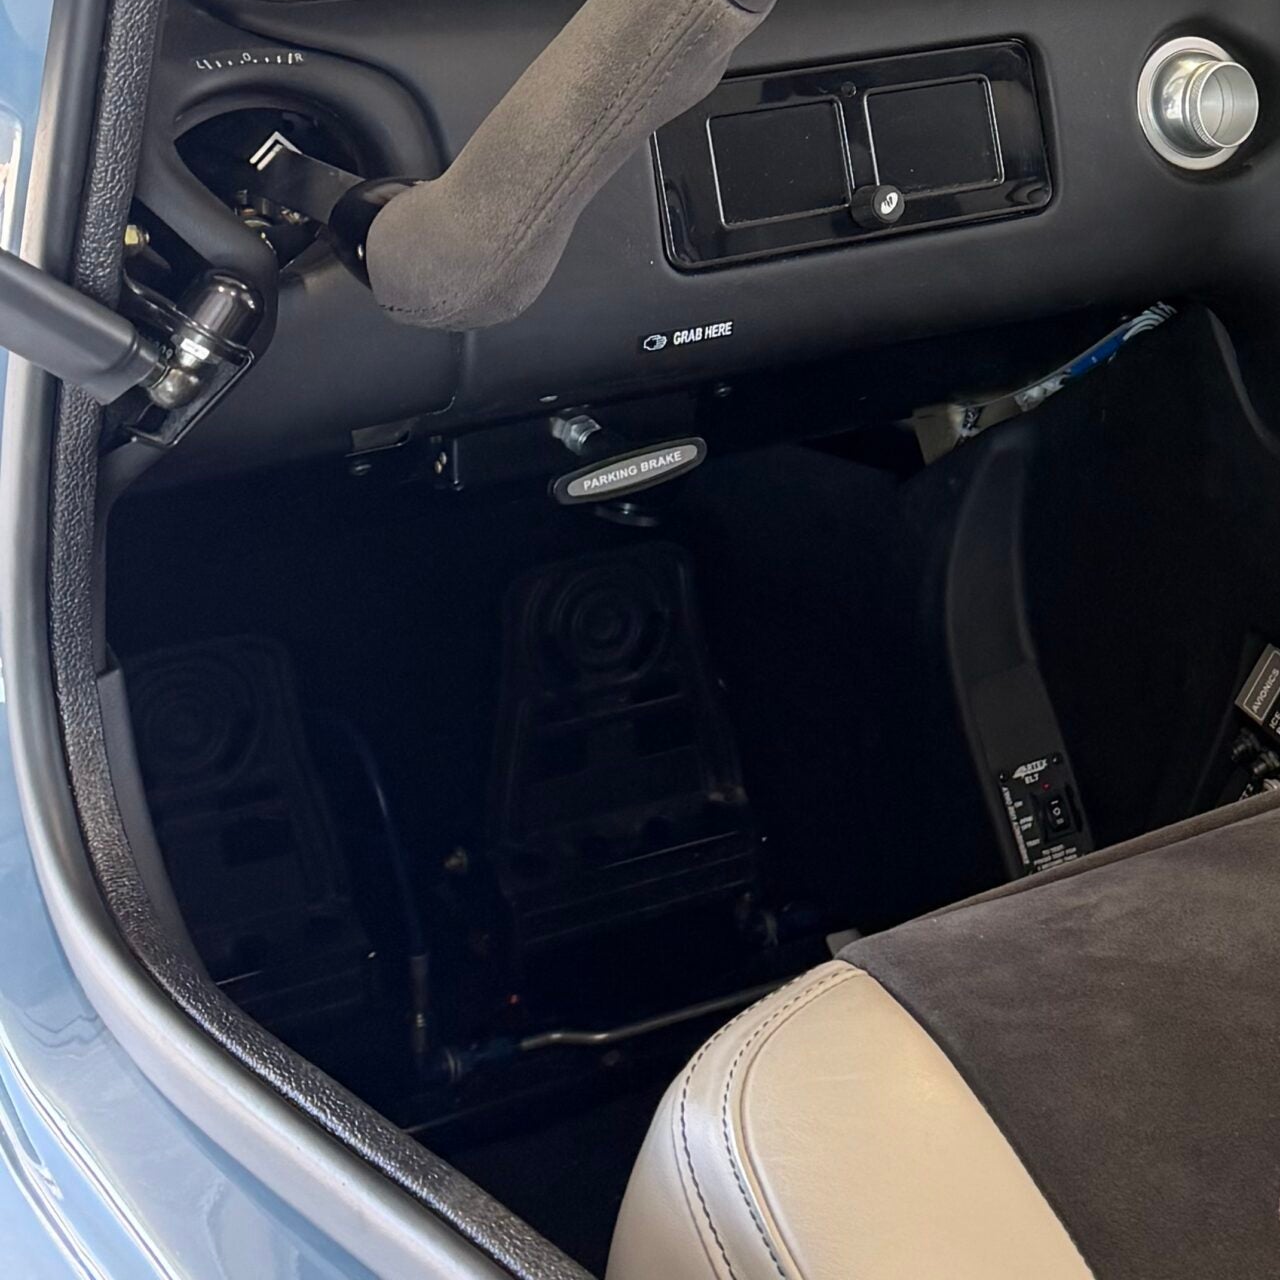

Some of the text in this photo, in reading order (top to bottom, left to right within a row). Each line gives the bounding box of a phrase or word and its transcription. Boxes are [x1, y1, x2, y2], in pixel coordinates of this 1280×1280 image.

[294, 52, 304, 62] R
[673, 321, 733, 346] GRAB HERE
[583, 450, 683, 491] PARKING BRAKE
[1252, 668, 1280, 714] AVIONICS
